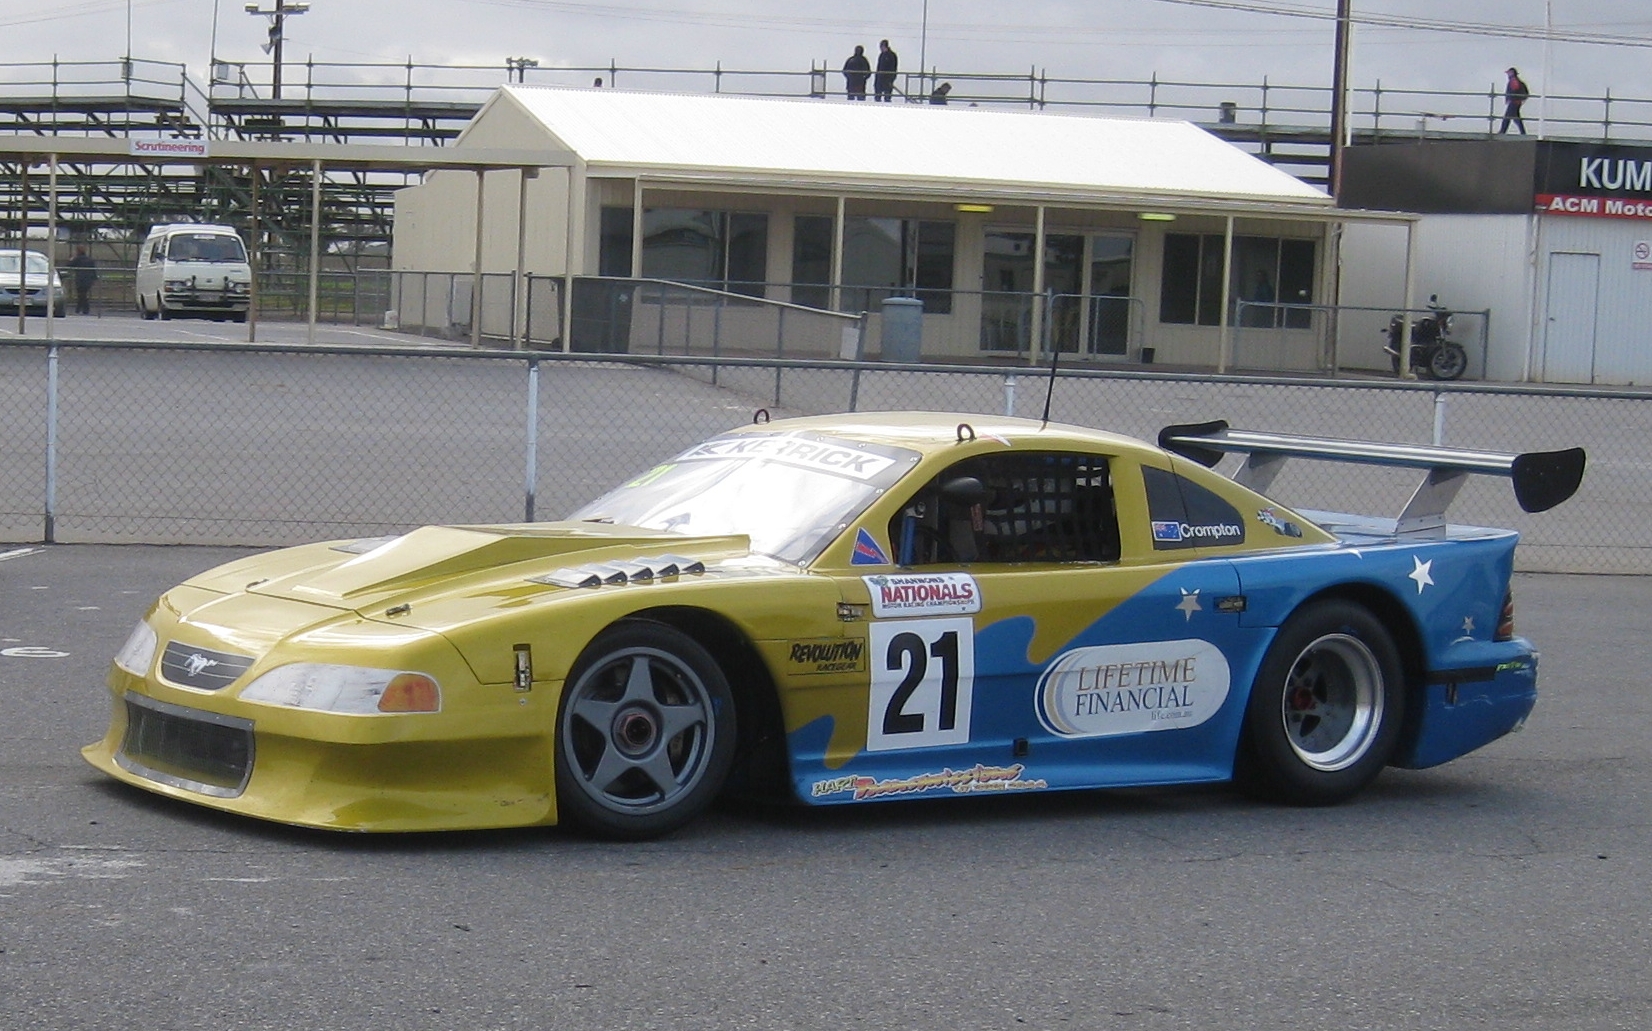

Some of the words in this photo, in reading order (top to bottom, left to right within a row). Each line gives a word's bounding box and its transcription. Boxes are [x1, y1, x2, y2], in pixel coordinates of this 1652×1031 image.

[135, 141, 205, 154] Scrutineering
[1580, 157, 1652, 191] KUM
[1548, 196, 1598, 213] ACM
[881, 583, 974, 603] NATIONALS
[790, 641, 863, 663] REVOLUTION
[882, 631, 958, 735] 21
[1077, 657, 1196, 691] LIFETIME
[1075, 685, 1194, 716] FINANCIAL
